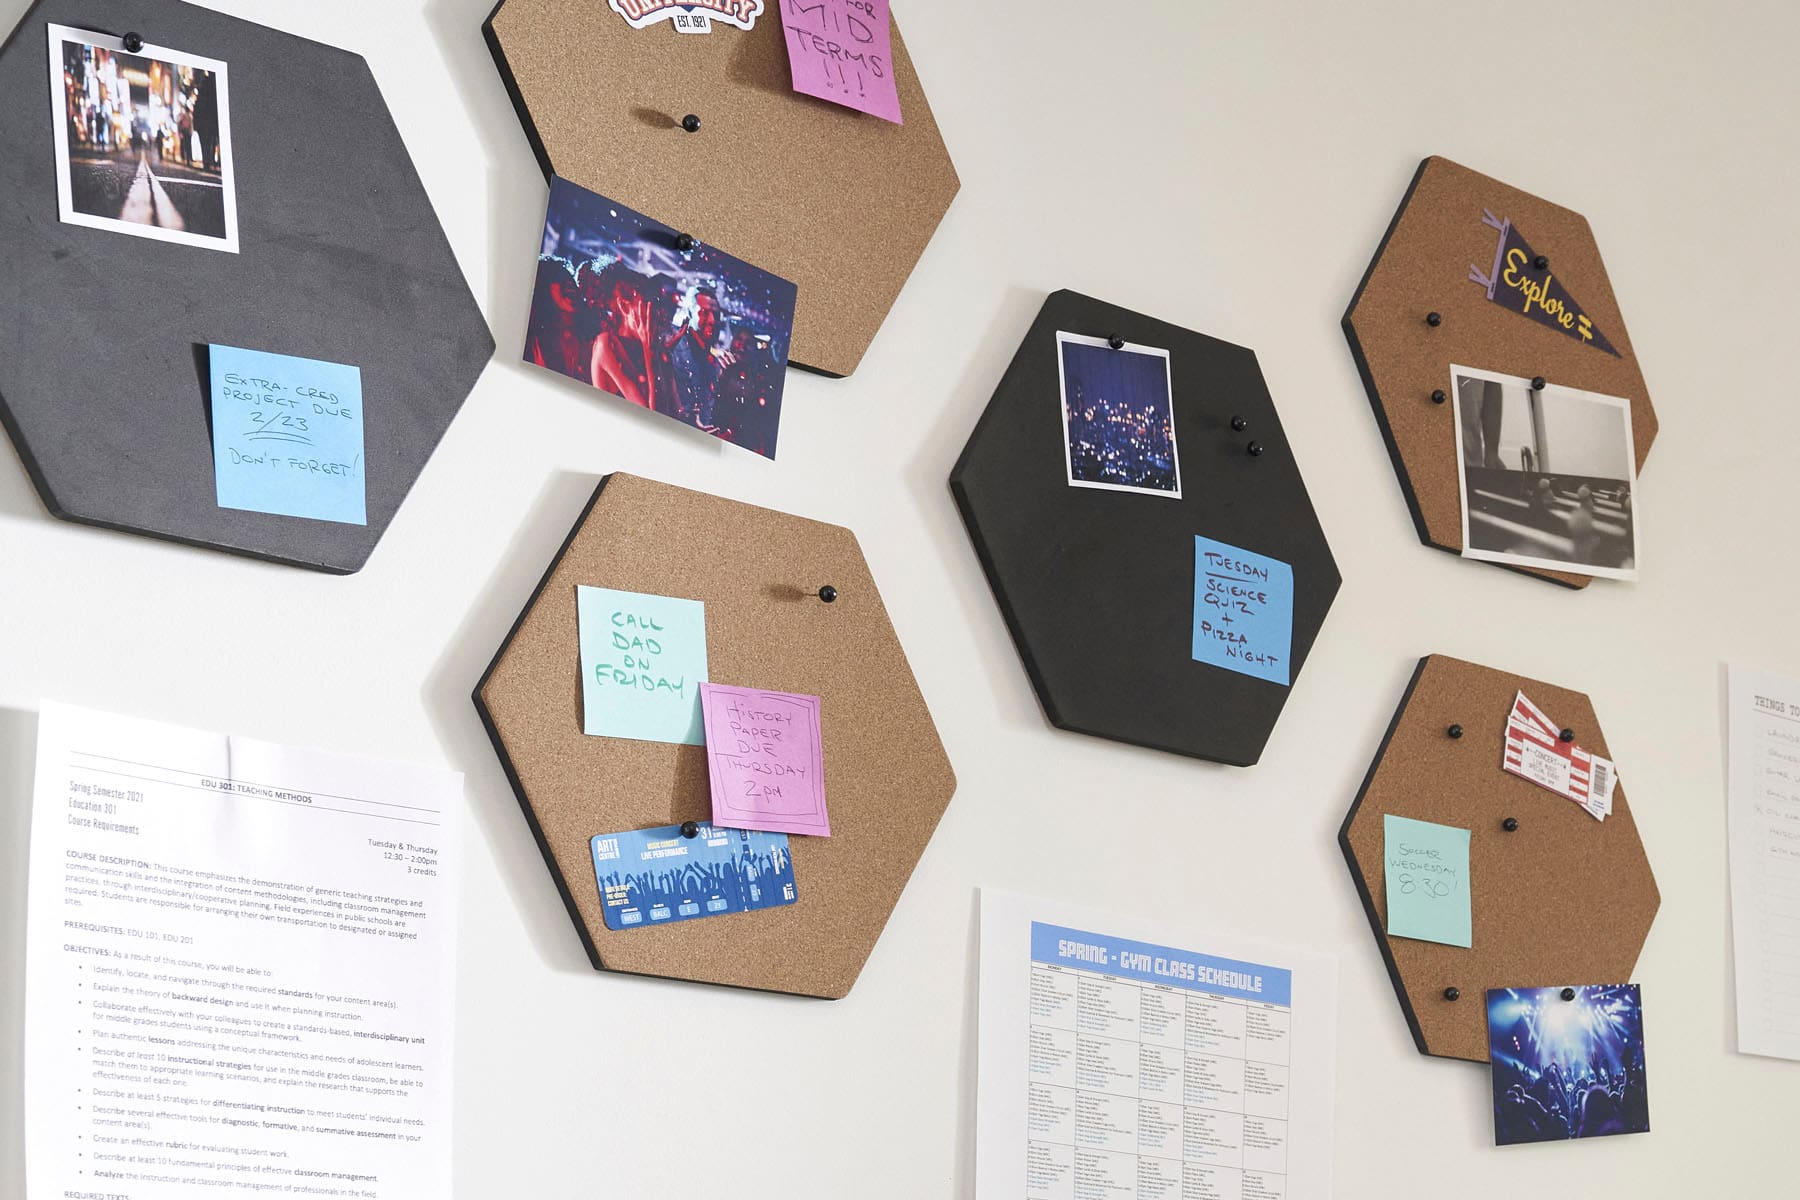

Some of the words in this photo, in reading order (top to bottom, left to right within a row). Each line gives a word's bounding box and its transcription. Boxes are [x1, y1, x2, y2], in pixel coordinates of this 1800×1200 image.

[677, 15, 692, 28] EST.
[693, 15, 707, 28] 1921
[786, 26, 883, 78] TERMS
[1503, 248, 1574, 329] Explore
[223, 386, 300, 408] PROJECT
[312, 403, 353, 420] DUE
[295, 386, 339, 404] CRED
[250, 411, 309, 434] 2/23
[228, 447, 281, 468] DON'T
[1204, 552, 1268, 582] TUESDAY
[1206, 578, 1267, 604] SCIENCE
[1203, 592, 1256, 615] QUIZ
[610, 611, 664, 631] CALL
[1221, 612, 1234, 627] +
[612, 631, 662, 655] DAD
[1201, 620, 1247, 644] PIZZA
[623, 654, 650, 671] ON
[595, 663, 684, 699] FRIDAY
[1754, 695, 1785, 712] THINGS
[1789, 704, 1800, 717] TO
[730, 721, 783, 742] PAPER
[737, 739, 778, 758] DUE
[715, 753, 806, 778] THURSDAY
[69, 780, 91, 795] Spring
[92, 784, 125, 799] Semester
[126, 790, 143, 802] 2021
[201, 779, 217, 790] EDU
[237, 784, 273, 797] TEACHING
[274, 792, 312, 803] METHODS
[68, 797, 102, 812] Education
[103, 803, 116, 814] 301
[67, 814, 91, 827] Course
[92, 818, 139, 834] Requirements
[368, 838, 398, 850] Tuesday
[398, 842, 405, 850] &
[405, 843, 437, 855] Thursday
[597, 839, 613, 854] ART
[383, 851, 404, 860] 12:30
[410, 855, 437, 865] 2:00pm
[65, 849, 97, 861] COURSE
[153, 863, 168, 872] This
[169, 867, 194, 876] course
[195, 871, 237, 882] emphasizes
[237, 876, 251, 884] the
[251, 879, 305, 891] demonstration
[314, 888, 342, 896] generic
[342, 891, 373, 902] teaching
[373, 896, 408, 906] strategies
[412, 868, 437, 876] credits
[65, 863, 123, 876] communication
[125, 871, 143, 879] skills
[144, 874, 158, 882] and
[173, 879, 214, 889] integration
[223, 886, 252, 895] content
[309, 897, 343, 909] including
[343, 902, 380, 912] classroom
[380, 908, 426, 918] management
[1058, 939, 1109, 965] SPRING
[1120, 951, 1152, 973] GYM
[1154, 957, 1196, 981] CLASS
[1197, 965, 1263, 993] SCHEDULE
